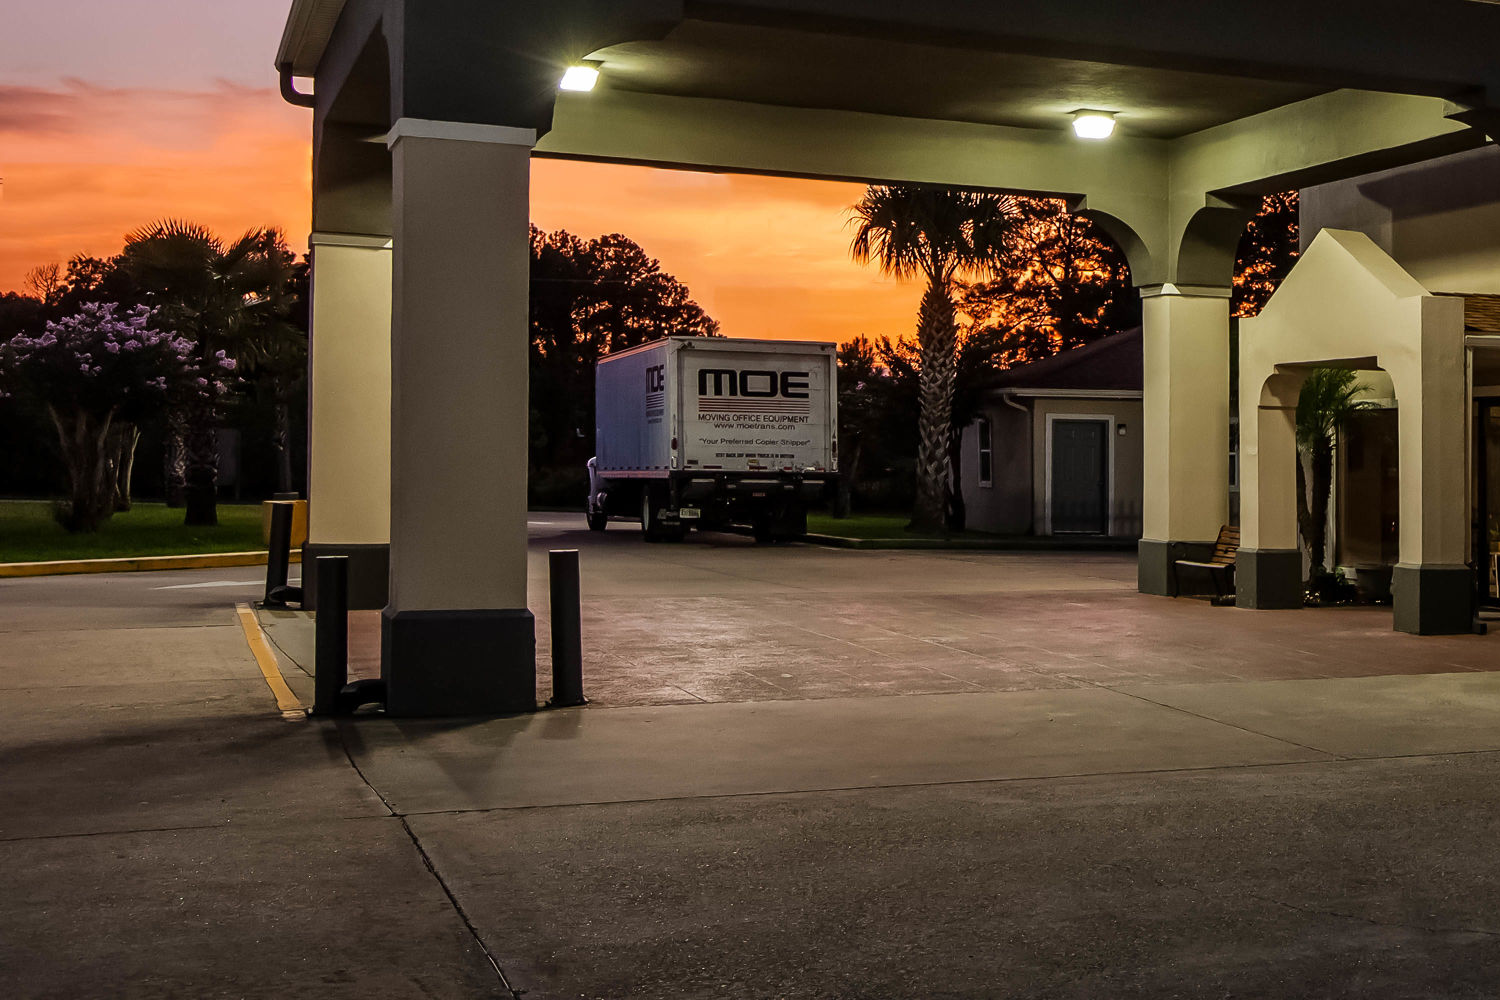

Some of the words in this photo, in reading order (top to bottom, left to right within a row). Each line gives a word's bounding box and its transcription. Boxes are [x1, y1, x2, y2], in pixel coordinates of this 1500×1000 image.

[698, 413, 731, 422] MOVING
[732, 413, 761, 423] OFFICE
[763, 414, 810, 424] EQUIPMENT
[713, 422, 796, 431] www.moetrans.com
[720, 437, 754, 446] Preferred
[755, 438, 780, 447] Copier
